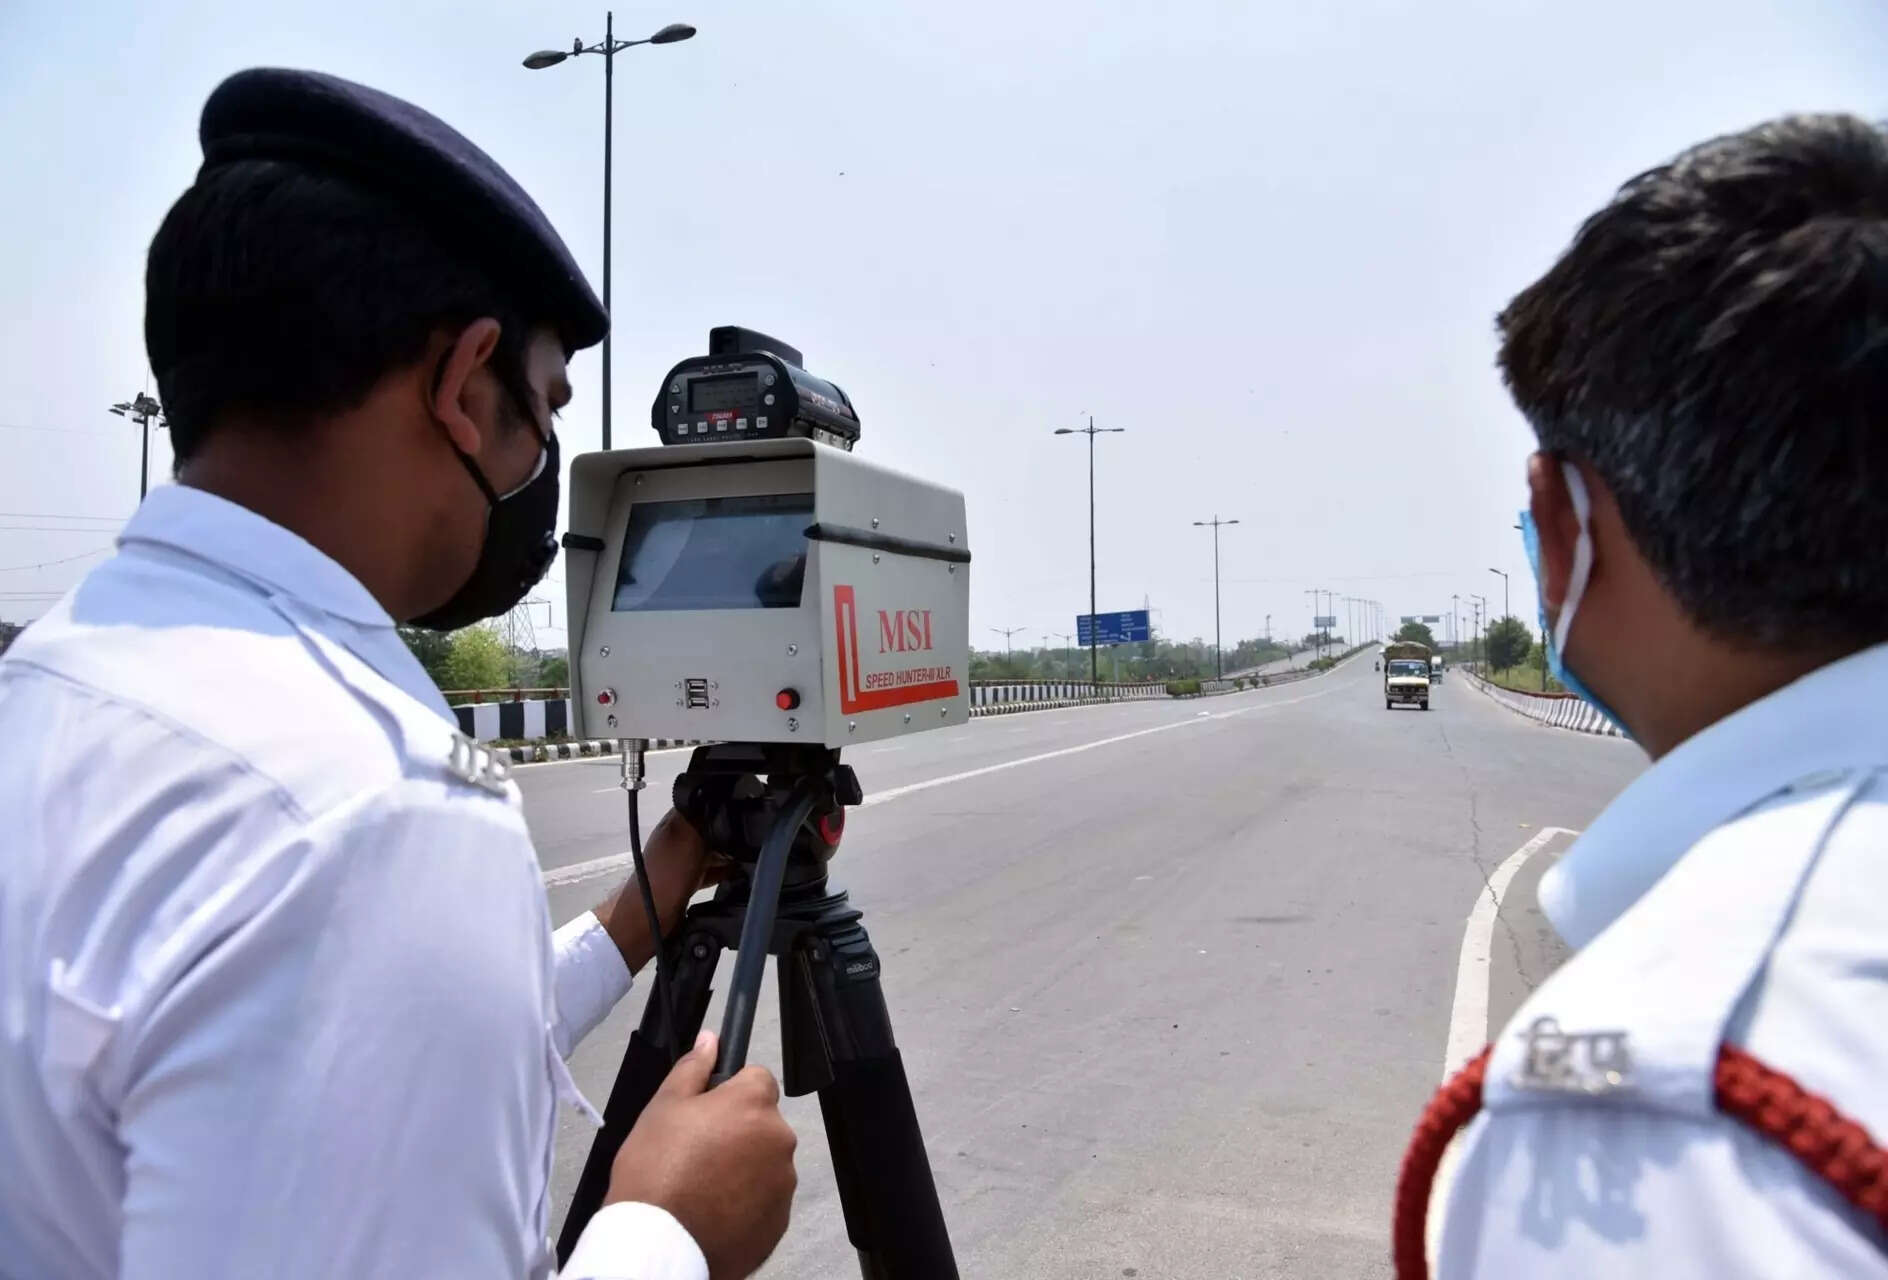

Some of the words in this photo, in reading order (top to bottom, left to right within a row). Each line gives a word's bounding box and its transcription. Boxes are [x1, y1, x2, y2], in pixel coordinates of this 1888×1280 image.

[876, 608, 934, 654] MSI
[865, 671, 894, 690] SPEED
[935, 665, 952, 681] XLR
